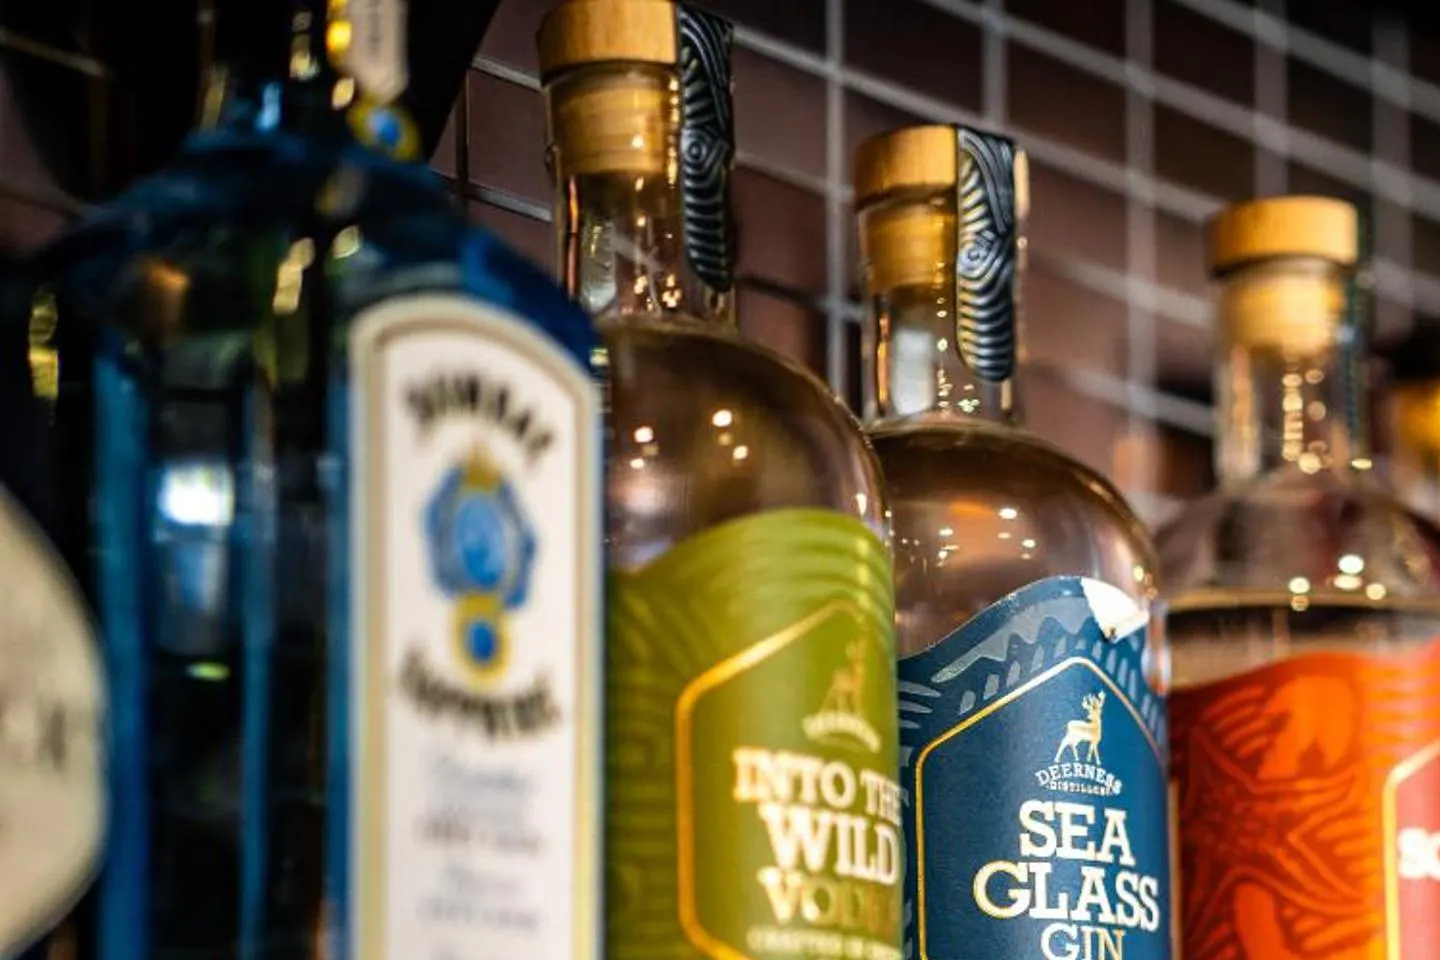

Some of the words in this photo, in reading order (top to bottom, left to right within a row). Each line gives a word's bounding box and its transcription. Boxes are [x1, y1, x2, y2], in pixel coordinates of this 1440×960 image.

[732, 747, 856, 810] INTO
[1035, 762, 1123, 795] DEERNESS
[758, 802, 900, 885] WILD
[1018, 799, 1137, 867] SEA
[972, 860, 1161, 932] GLASS
